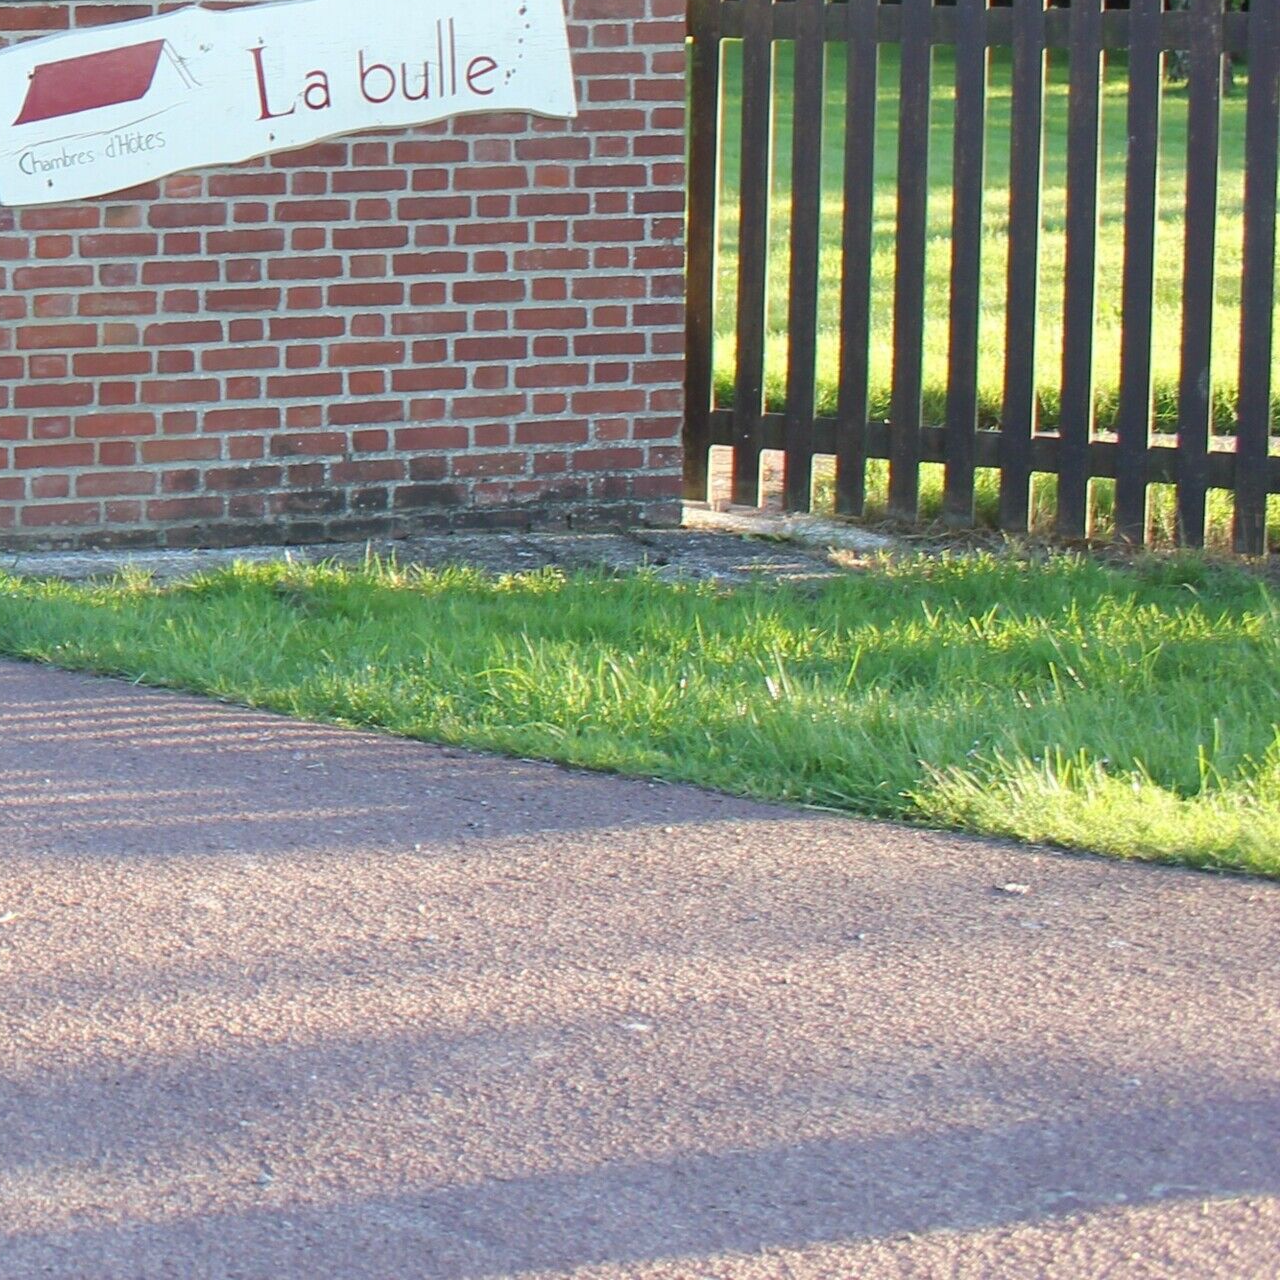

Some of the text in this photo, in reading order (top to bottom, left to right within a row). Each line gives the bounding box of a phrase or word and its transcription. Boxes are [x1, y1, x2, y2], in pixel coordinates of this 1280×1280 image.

[246, 17, 498, 121] La bulle
[18, 147, 95, 175] Chambres
